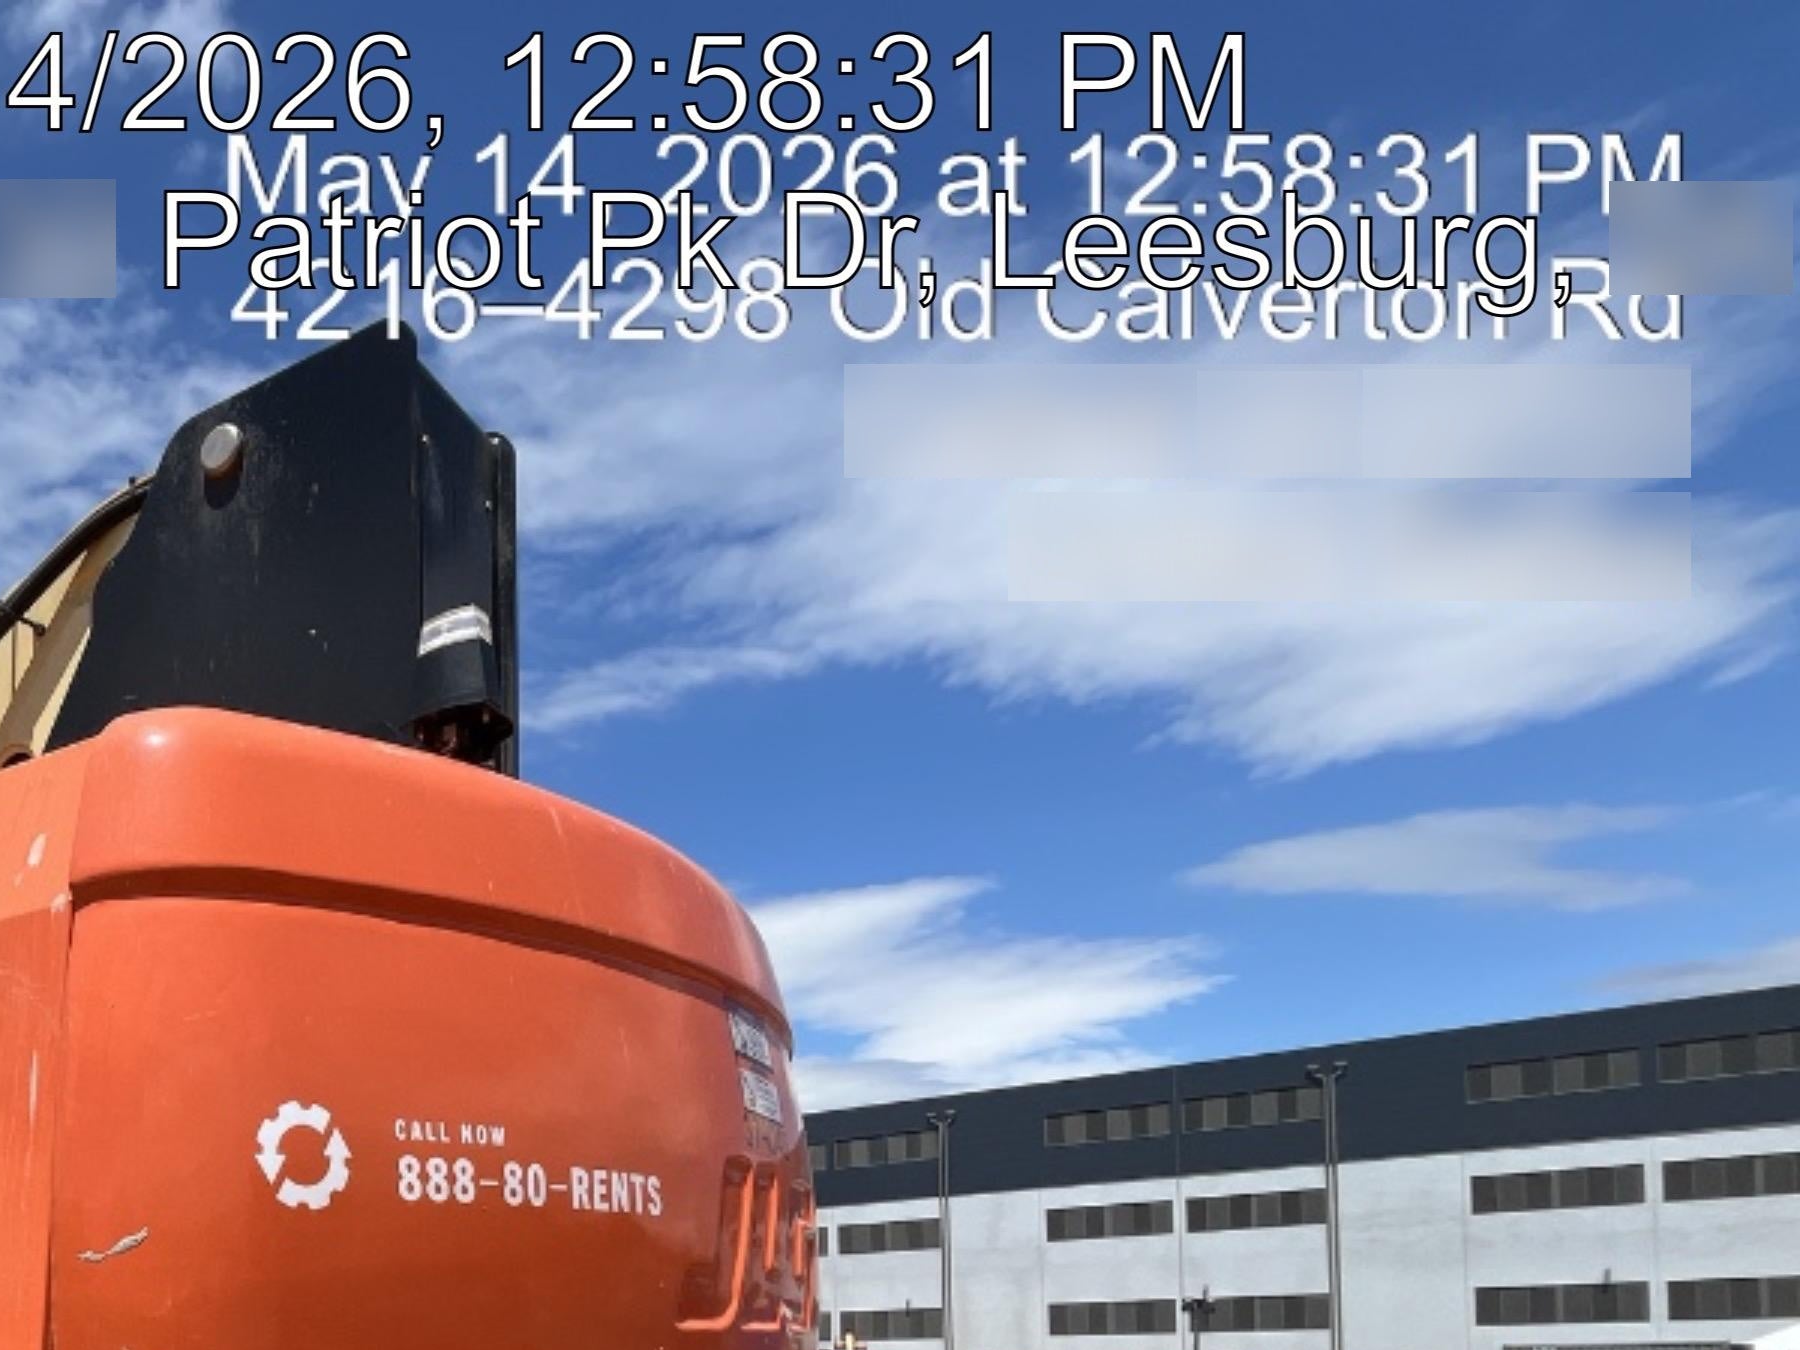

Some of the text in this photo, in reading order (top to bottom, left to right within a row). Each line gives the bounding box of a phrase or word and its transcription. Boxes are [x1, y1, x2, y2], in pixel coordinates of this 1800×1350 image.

[394, 1118, 505, 1147] CALL NOW
[397, 1154, 664, 1217] 888-80-RENTS
